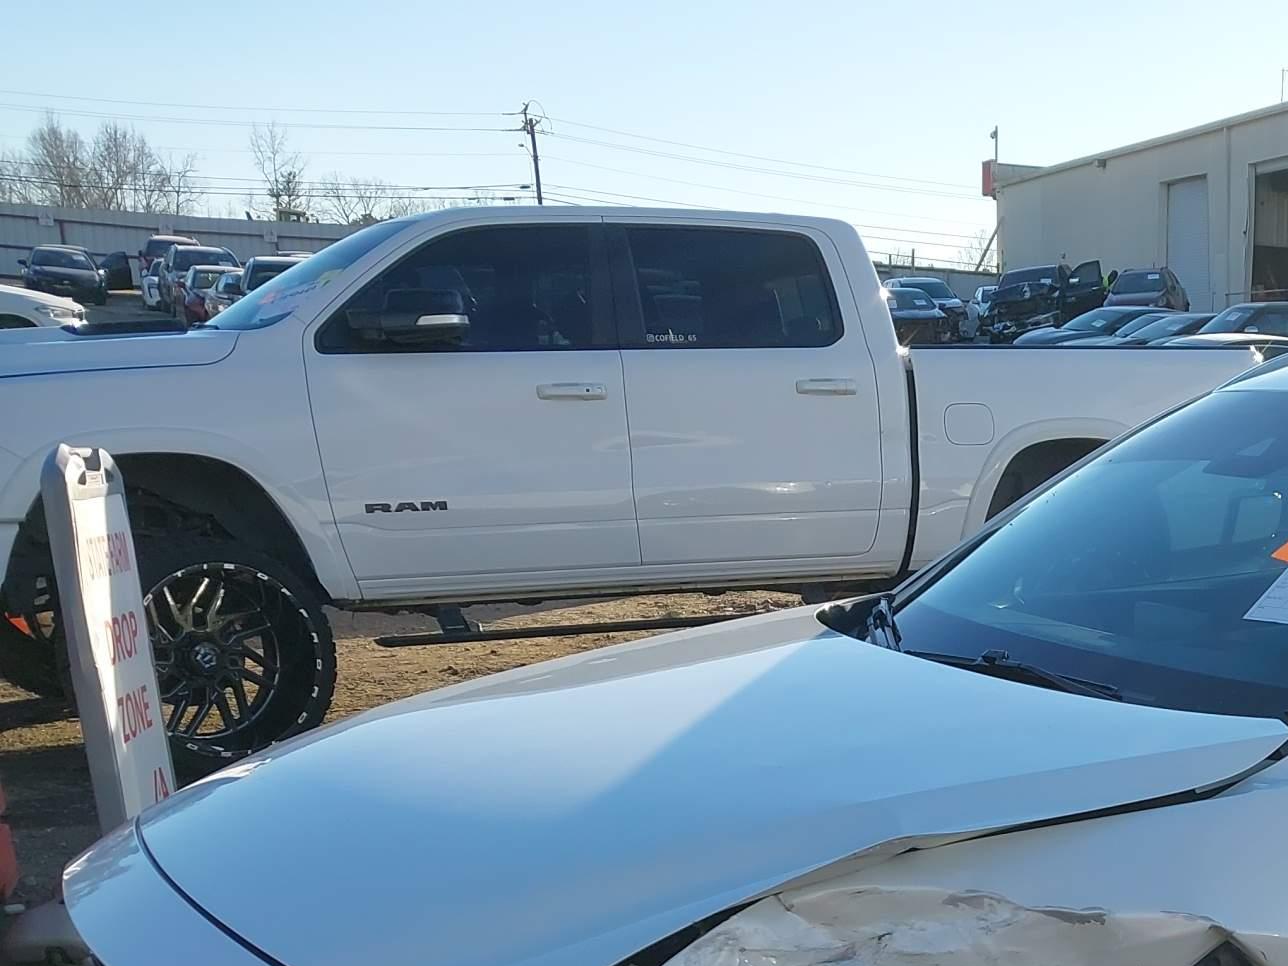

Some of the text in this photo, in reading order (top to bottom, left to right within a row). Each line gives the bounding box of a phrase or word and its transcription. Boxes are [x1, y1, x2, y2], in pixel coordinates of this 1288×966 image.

[365, 501, 448, 514] RAM
[105, 611, 138, 666] DROP
[117, 685, 153, 744] ZONE
